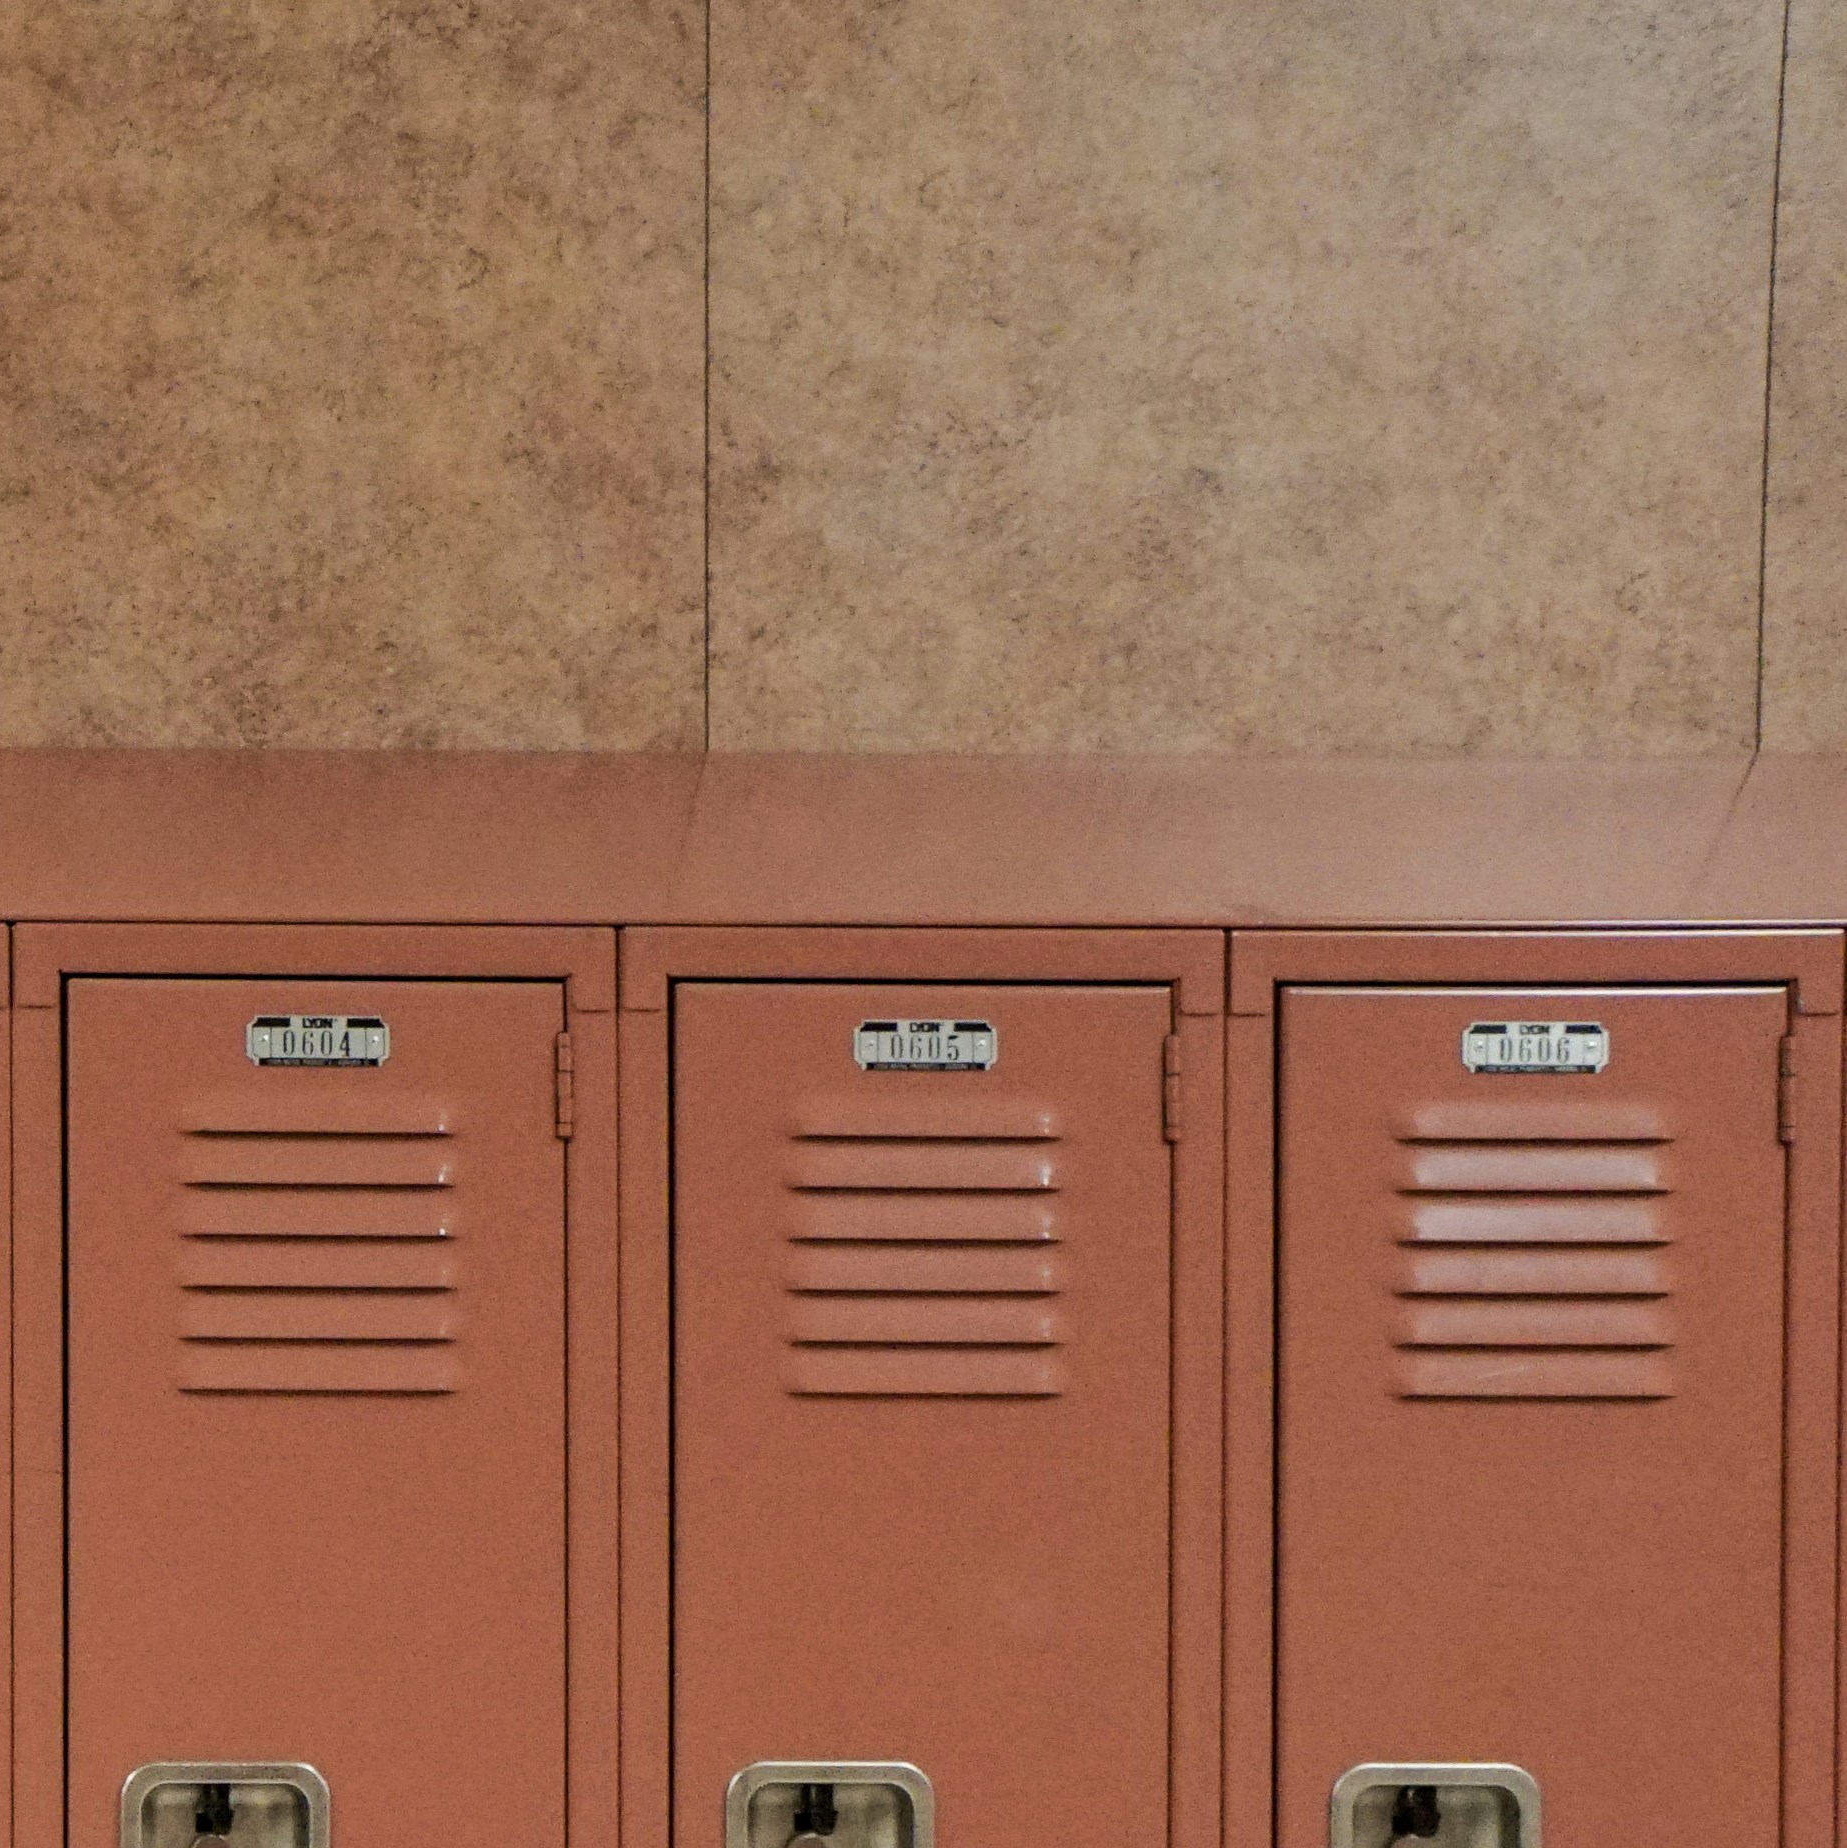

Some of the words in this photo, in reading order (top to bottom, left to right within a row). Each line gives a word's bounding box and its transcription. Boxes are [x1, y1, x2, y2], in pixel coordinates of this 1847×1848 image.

[303, 1018, 333, 1028] LYON
[909, 1023, 939, 1032] LYON
[1520, 1025, 1549, 1034] LYON
[283, 1031, 351, 1056] 0604
[891, 1035, 959, 1061] 0605
[1500, 1038, 1569, 1063] 0606
